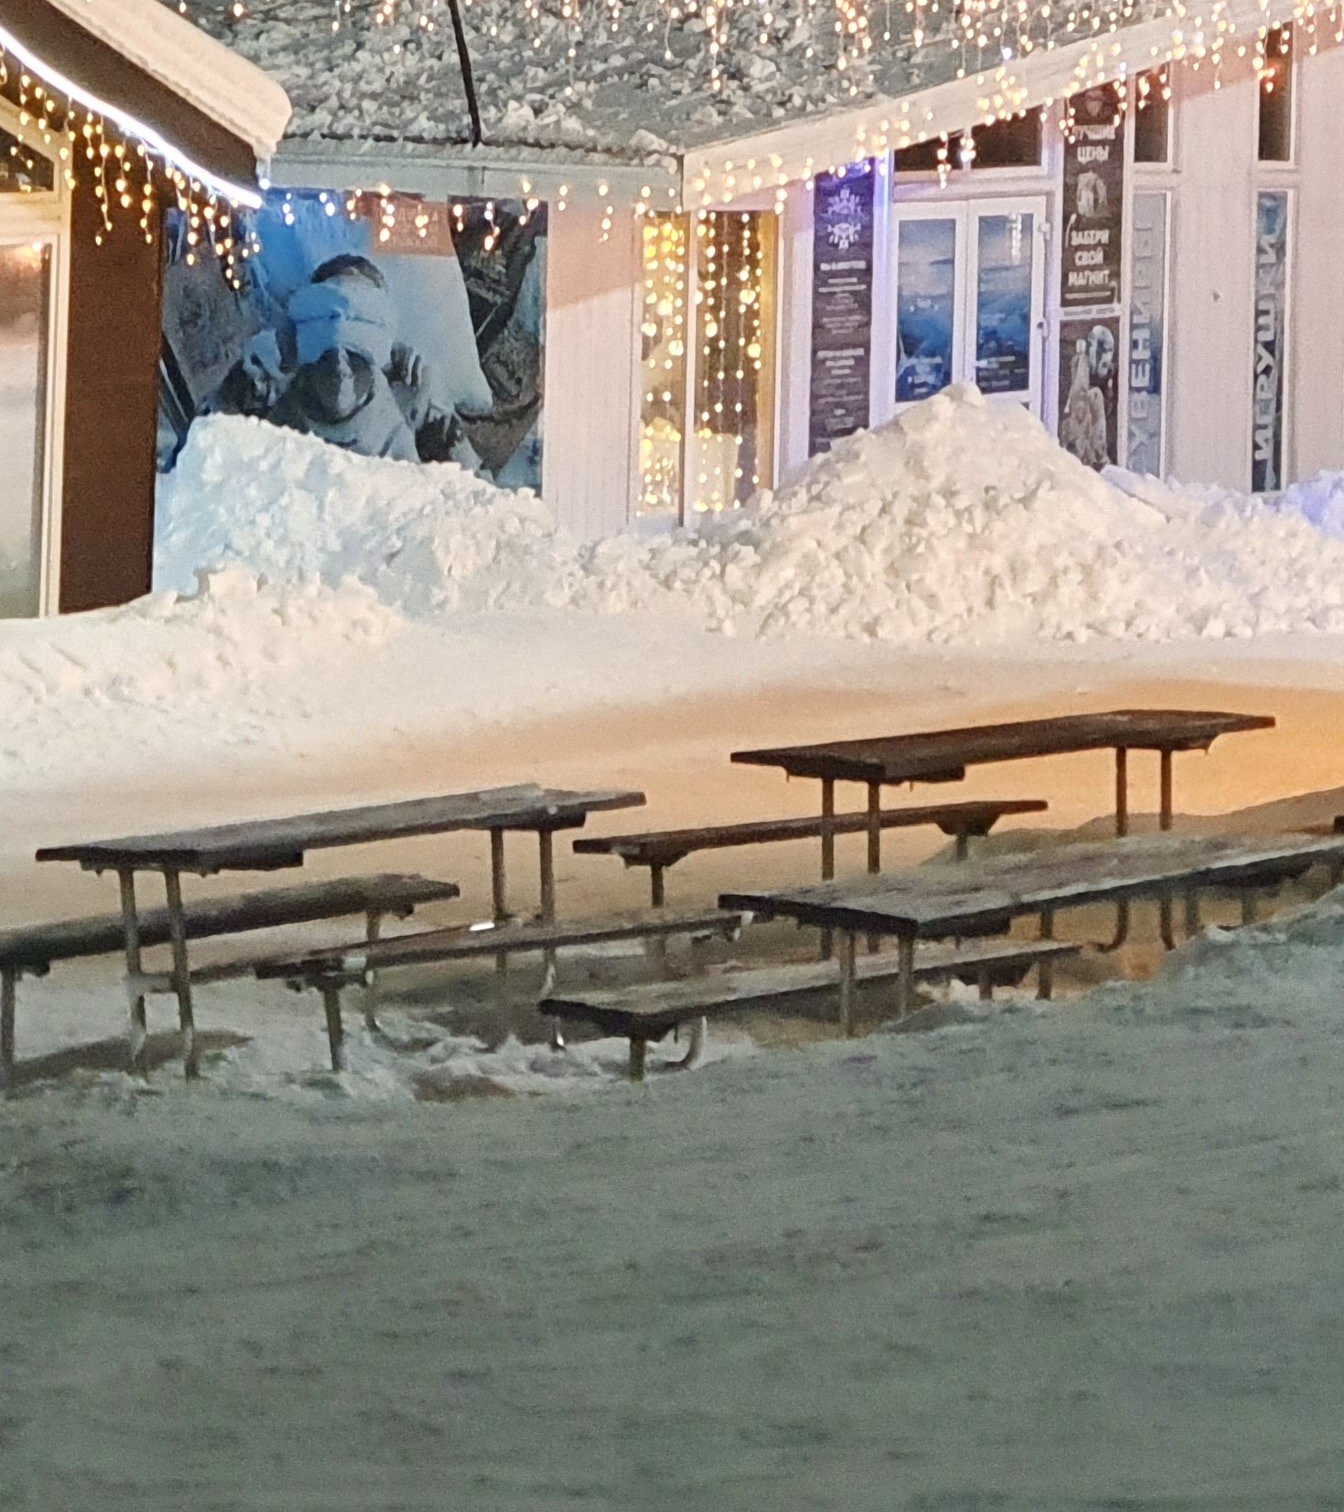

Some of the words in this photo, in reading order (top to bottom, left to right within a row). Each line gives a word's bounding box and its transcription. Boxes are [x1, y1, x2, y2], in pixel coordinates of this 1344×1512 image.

[1074, 247, 1104, 266] СВОЙ
[1068, 269, 1110, 286] МАГНИТ
[1255, 234, 1276, 461] ИГРУШКИ
